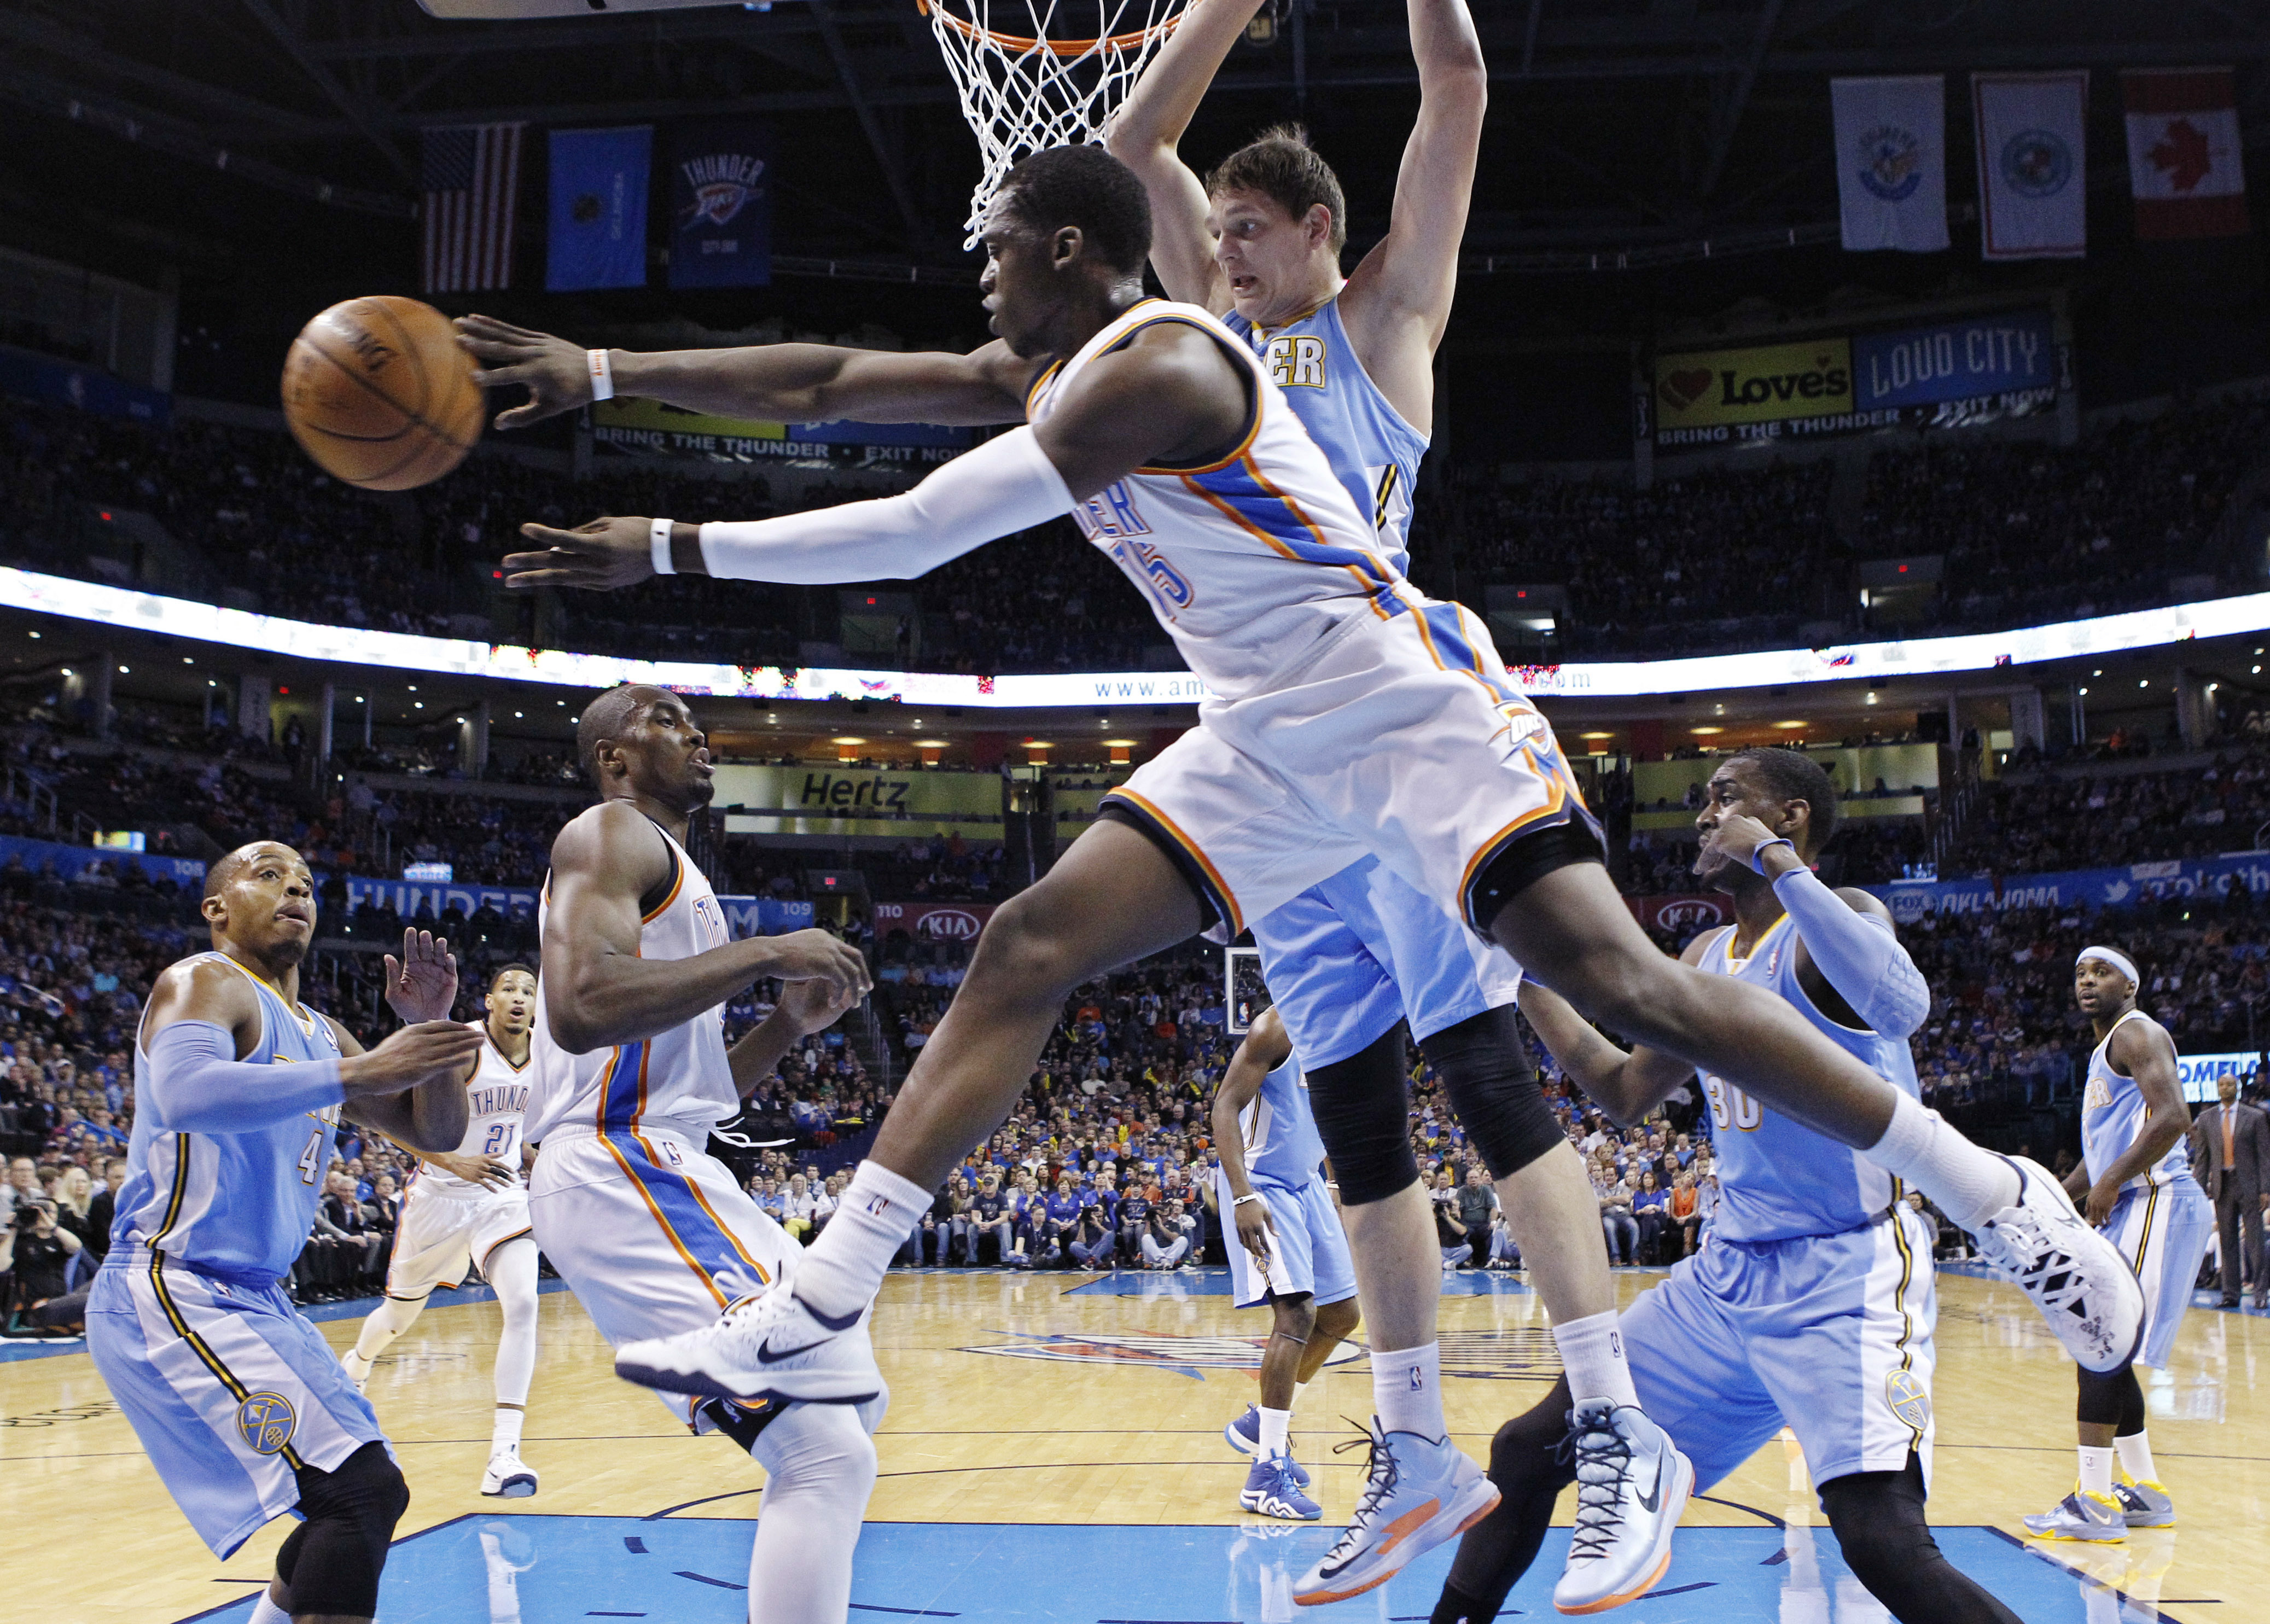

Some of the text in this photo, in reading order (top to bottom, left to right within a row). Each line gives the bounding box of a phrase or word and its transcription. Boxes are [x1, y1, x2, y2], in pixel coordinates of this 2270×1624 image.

[682, 154, 765, 188] THUNDER
[1871, 328, 2038, 398] LOUD CITY
[1736, 421, 1782, 439] THE
[1788, 409, 1901, 434] THUNDER
[671, 434, 717, 450] THE
[723, 438, 829, 458] THUNDER
[864, 446, 915, 461] EXIT
[801, 773, 911, 806] Hertz
[782, 903, 812, 916] 109
[877, 905, 903, 918] 110
[928, 916, 971, 936] KIA
[470, 1085, 529, 1117] THUND
[1706, 1073, 1763, 1132] 30
[484, 1123, 518, 1156] 21
[296, 1128, 324, 1186] 4
